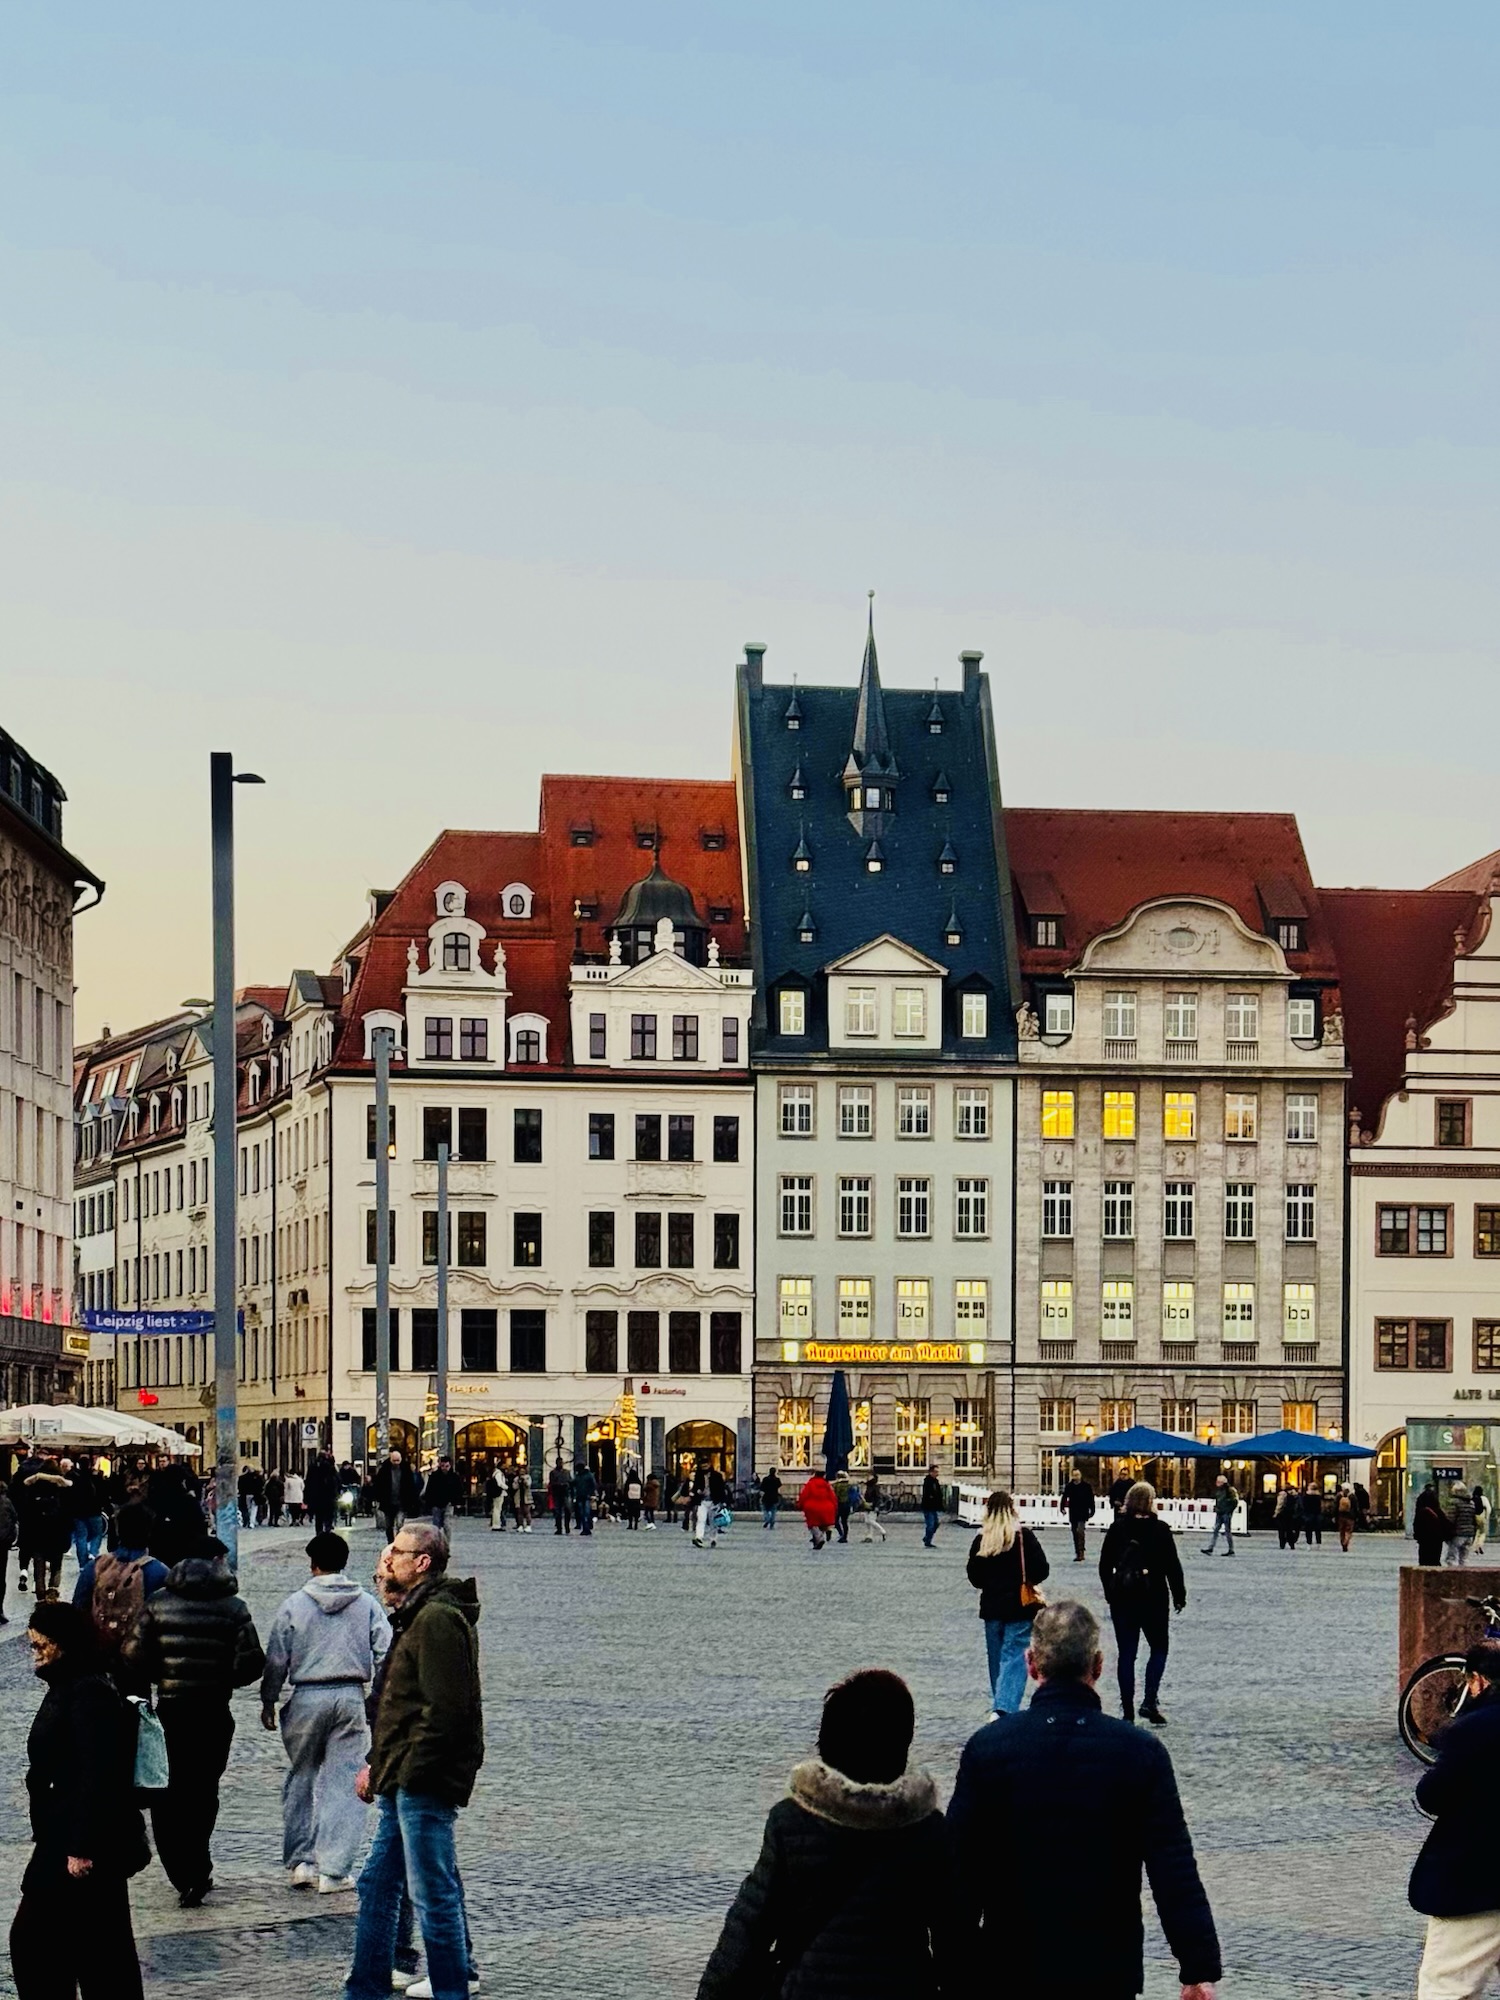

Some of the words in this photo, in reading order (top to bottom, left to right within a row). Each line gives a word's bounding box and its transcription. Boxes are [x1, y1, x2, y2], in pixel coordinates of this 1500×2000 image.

[95, 1314, 144, 1331] Leipzig
[146, 1314, 177, 1328] liest
[806, 1342, 888, 1362] Augustiner
[889, 1346, 913, 1361] am
[916, 1342, 963, 1361] Markt
[1453, 1389, 1482, 1400] ALTE
[1442, 1432, 1453, 1444] S
